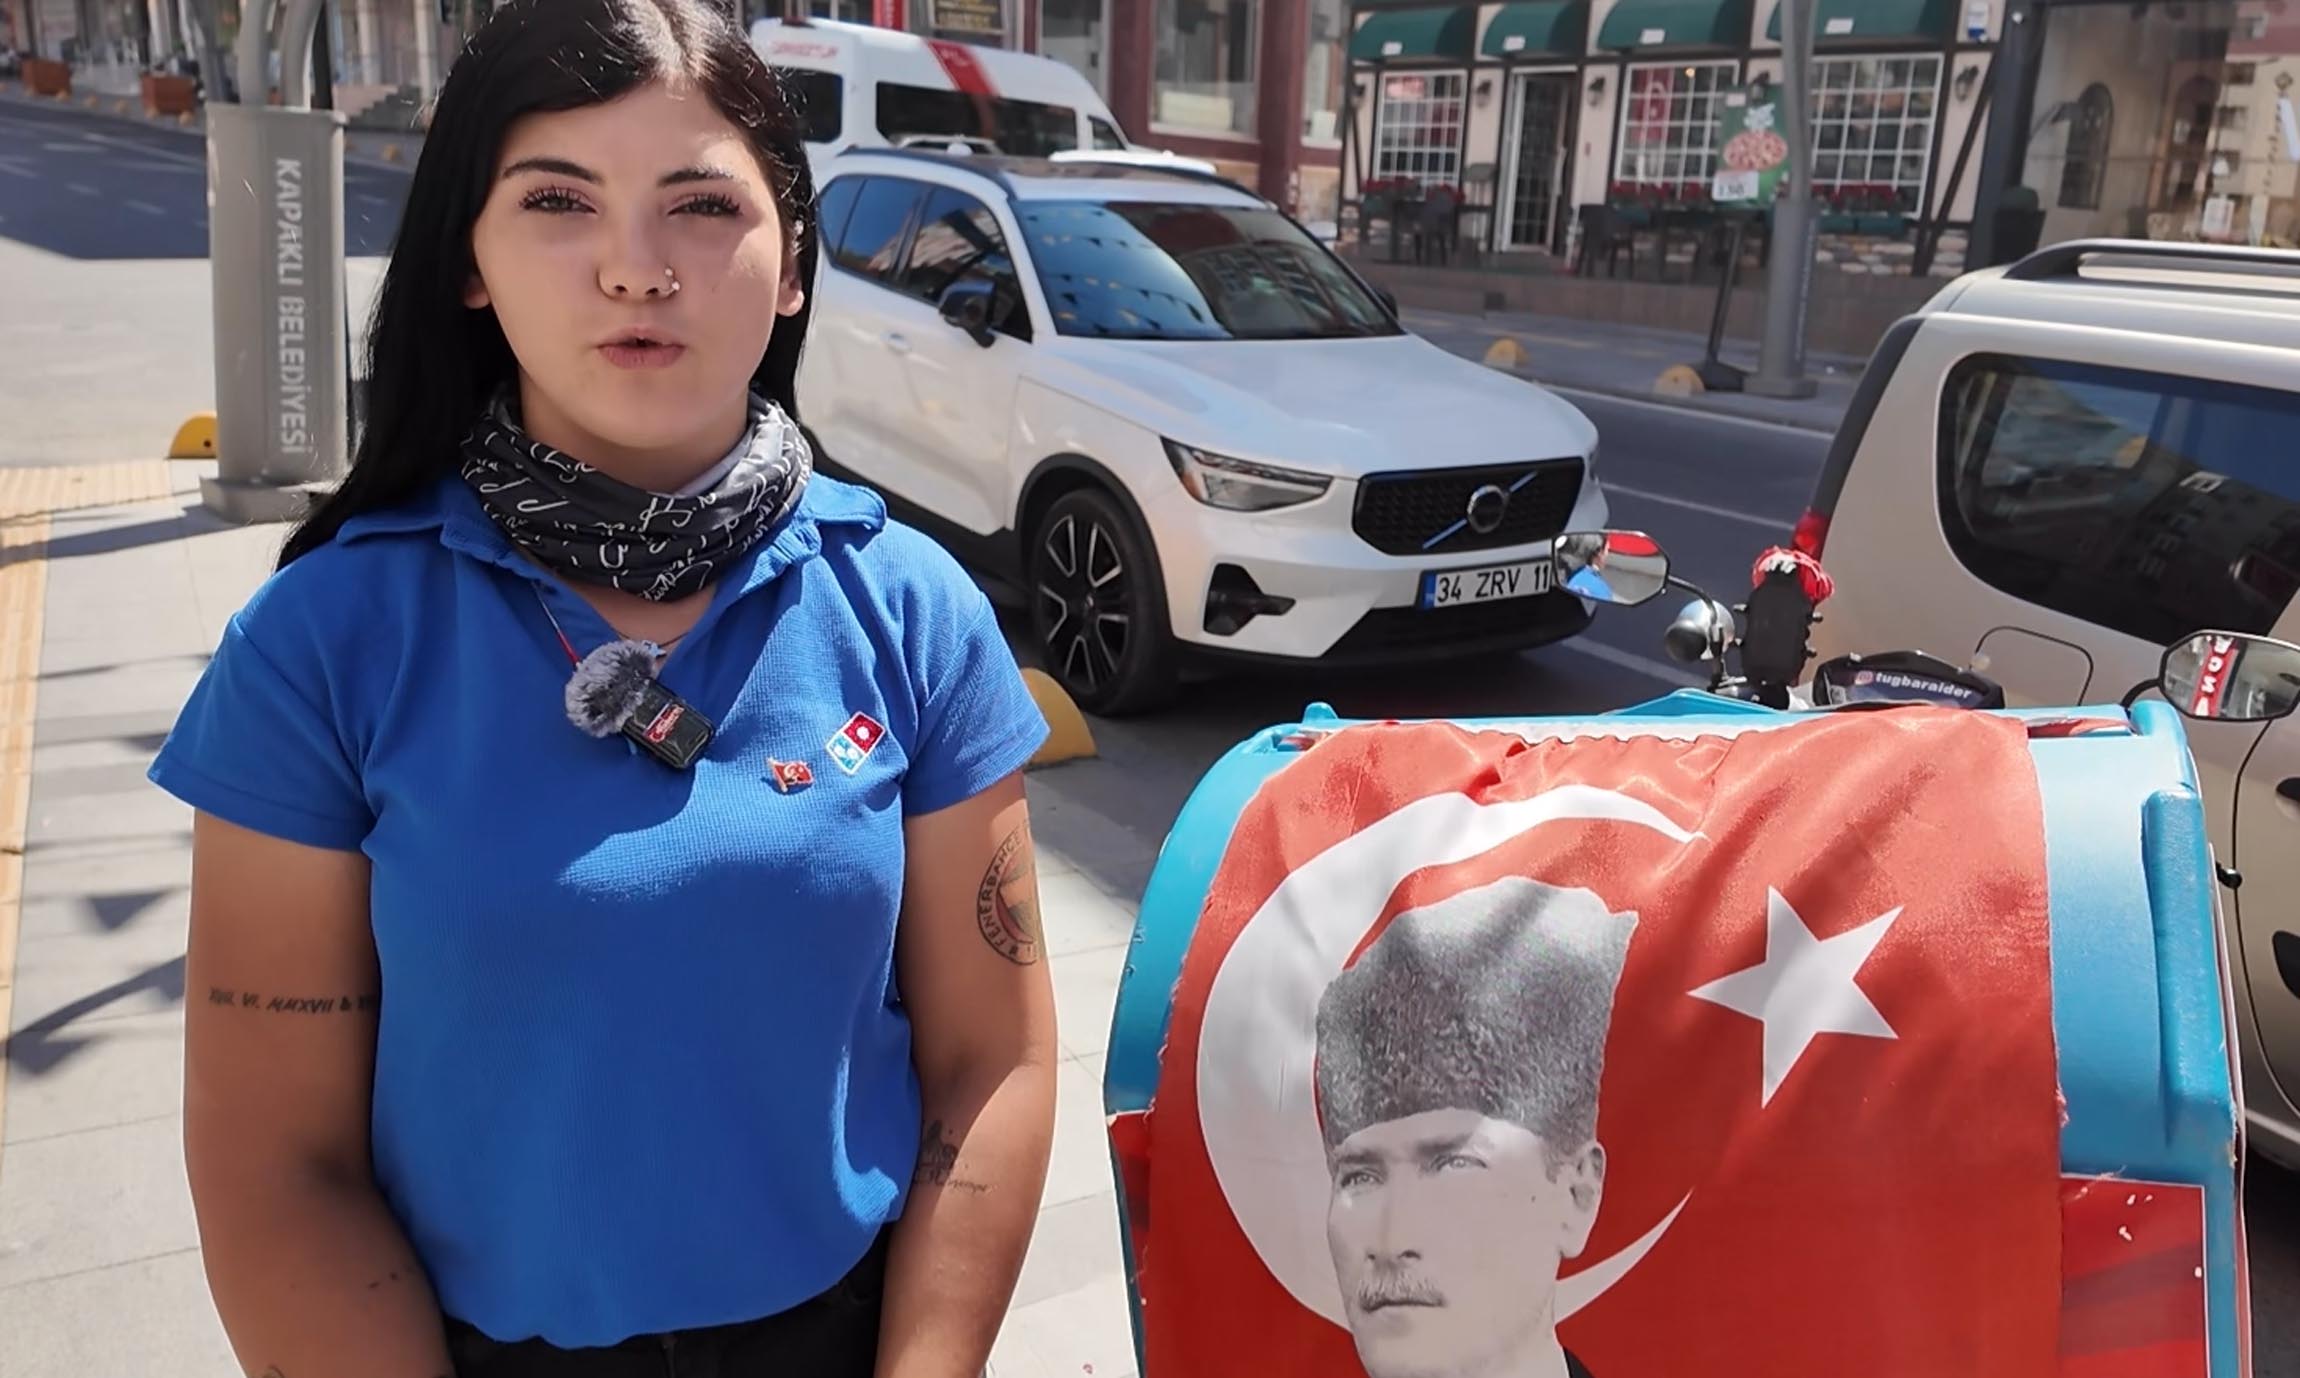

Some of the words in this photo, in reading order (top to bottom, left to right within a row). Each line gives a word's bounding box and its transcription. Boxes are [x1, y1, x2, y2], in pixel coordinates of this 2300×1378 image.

[276, 157, 304, 286] KAPAKLI
[278, 296, 313, 453] BELEDİYESİ
[1437, 575, 1462, 603] 34
[1475, 567, 1521, 599] ZRV
[1876, 672, 1972, 699] tugbaraider
